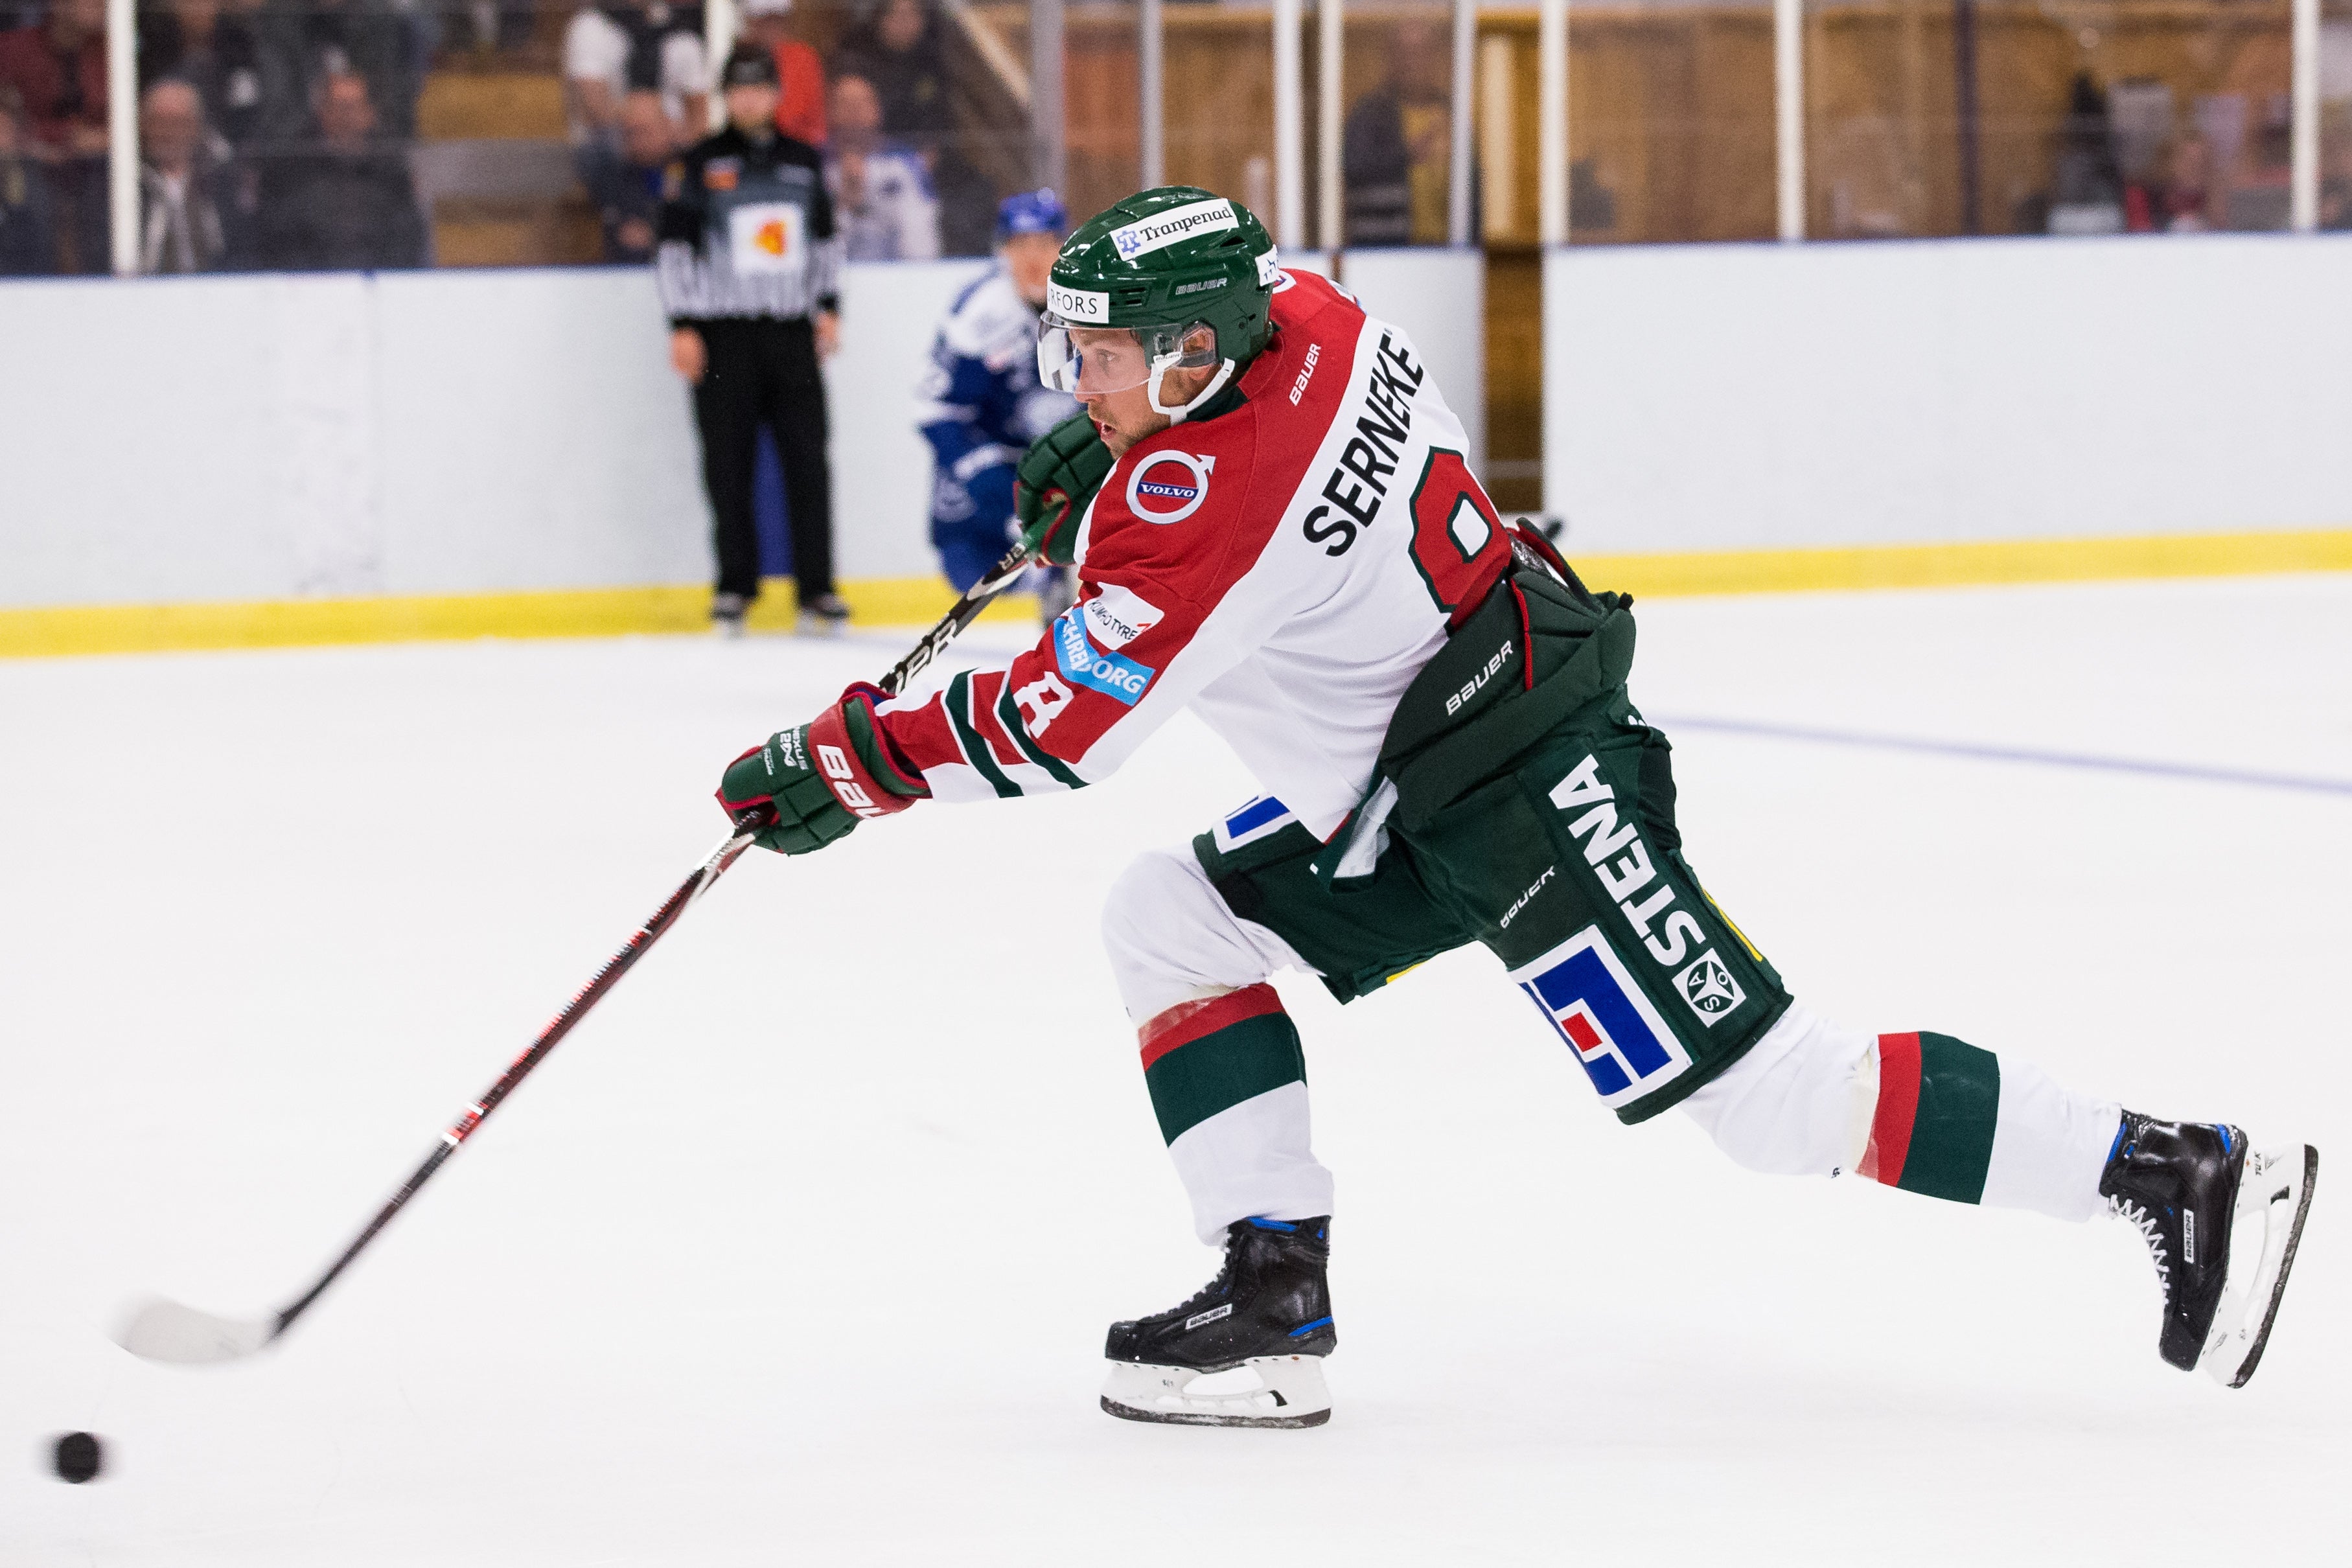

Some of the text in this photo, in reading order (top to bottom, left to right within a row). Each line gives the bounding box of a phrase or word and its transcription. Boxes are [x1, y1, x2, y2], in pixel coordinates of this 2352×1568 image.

[1140, 207, 1232, 241] Tranpenad
[1048, 287, 1097, 314] RFORS
[1175, 277, 1228, 295] BAUER
[1289, 343, 1321, 406] BAUER
[1303, 332, 1424, 557] SERNEKE
[1141, 483, 1195, 497] VOLVO
[1111, 618, 1138, 640] TYRE
[1446, 640, 1513, 715] BAUER
[1549, 754, 1706, 967] STENA
